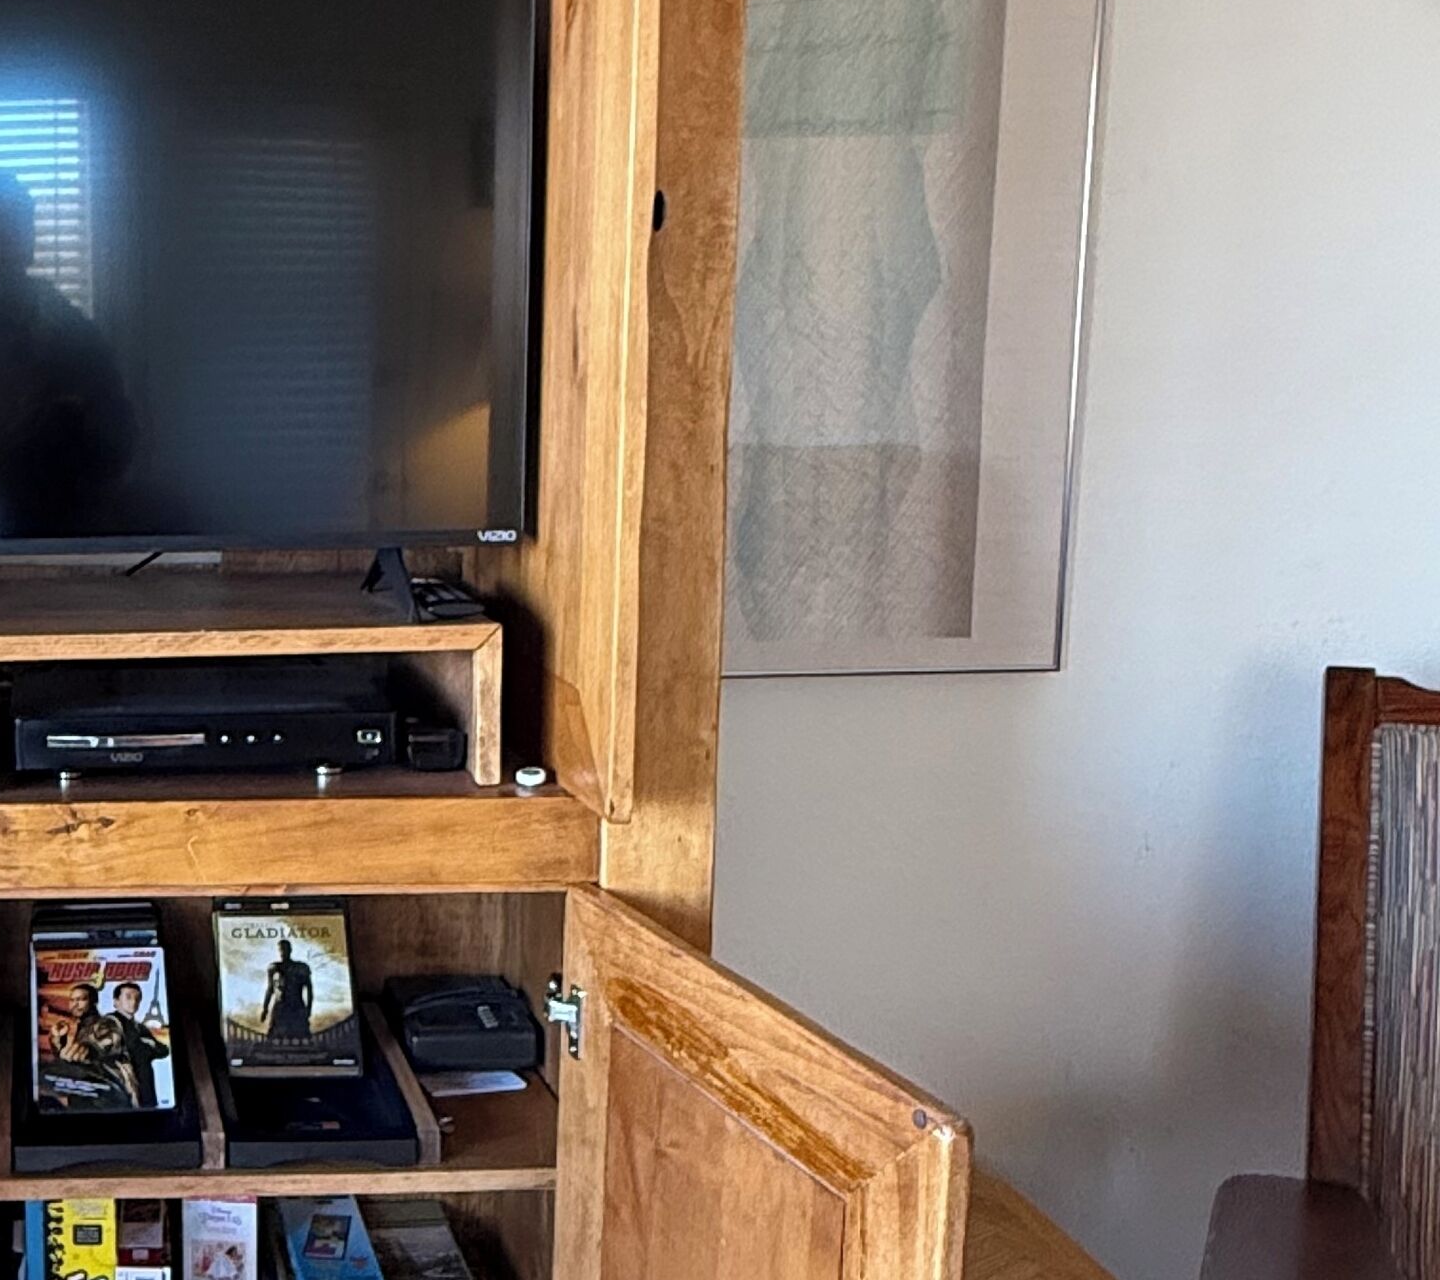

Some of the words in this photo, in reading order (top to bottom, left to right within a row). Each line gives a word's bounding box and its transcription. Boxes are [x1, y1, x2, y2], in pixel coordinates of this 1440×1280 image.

[477, 529, 517, 542] VIZIO
[110, 752, 144, 763] VIZIO
[231, 926, 331, 939] GLADIATOR
